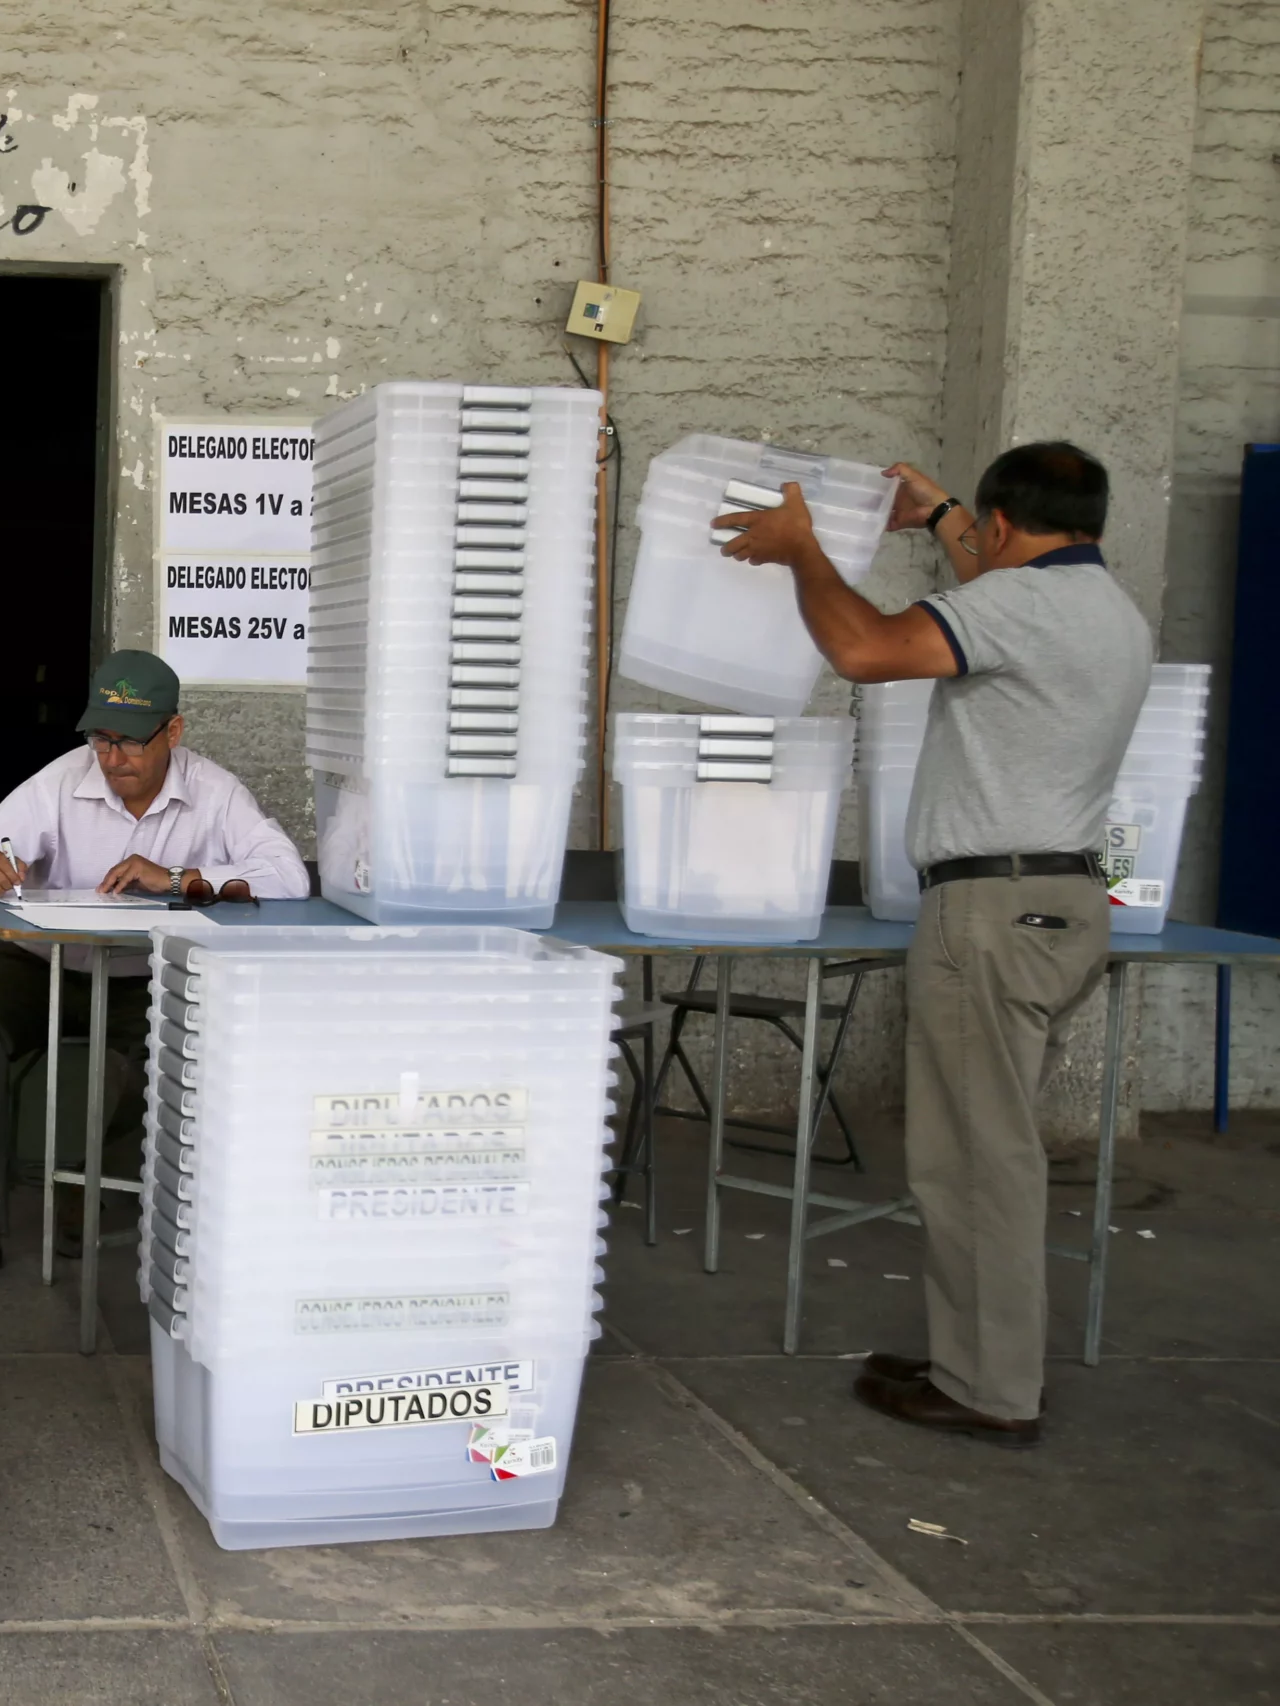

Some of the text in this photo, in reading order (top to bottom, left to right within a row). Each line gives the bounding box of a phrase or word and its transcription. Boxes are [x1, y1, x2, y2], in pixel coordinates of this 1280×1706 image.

[168, 435, 248, 460] DELEGADO
[169, 491, 248, 516] MESAS
[255, 493, 284, 516] 1V
[290, 500, 303, 517] a
[167, 565, 311, 591] DELEGADO ELECTO
[168, 615, 306, 640] MESAS 25V a
[312, 1388, 493, 1429] DIPUTADOS
